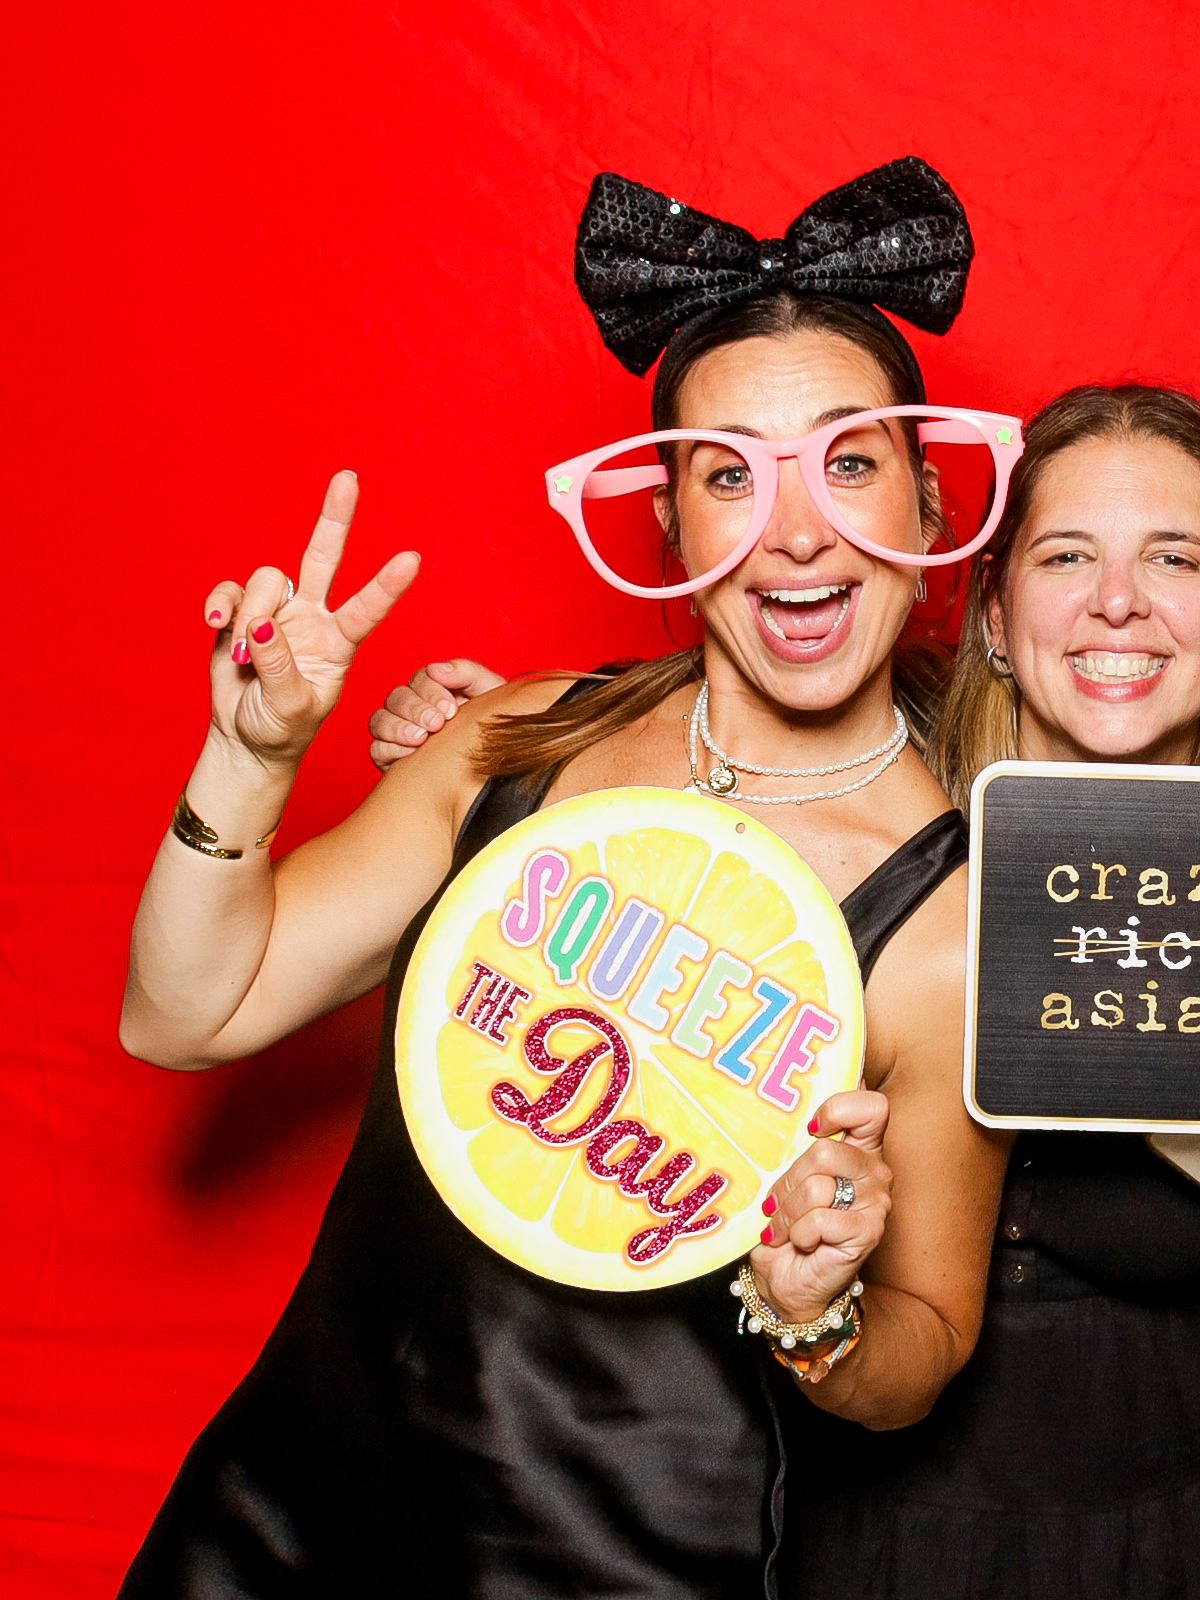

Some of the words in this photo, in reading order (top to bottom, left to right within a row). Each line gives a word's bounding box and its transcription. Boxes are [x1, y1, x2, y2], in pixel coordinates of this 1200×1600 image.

[454, 962, 532, 1045] THE
[502, 850, 839, 1111] SQUEEZE
[492, 1008, 728, 1265] Day
